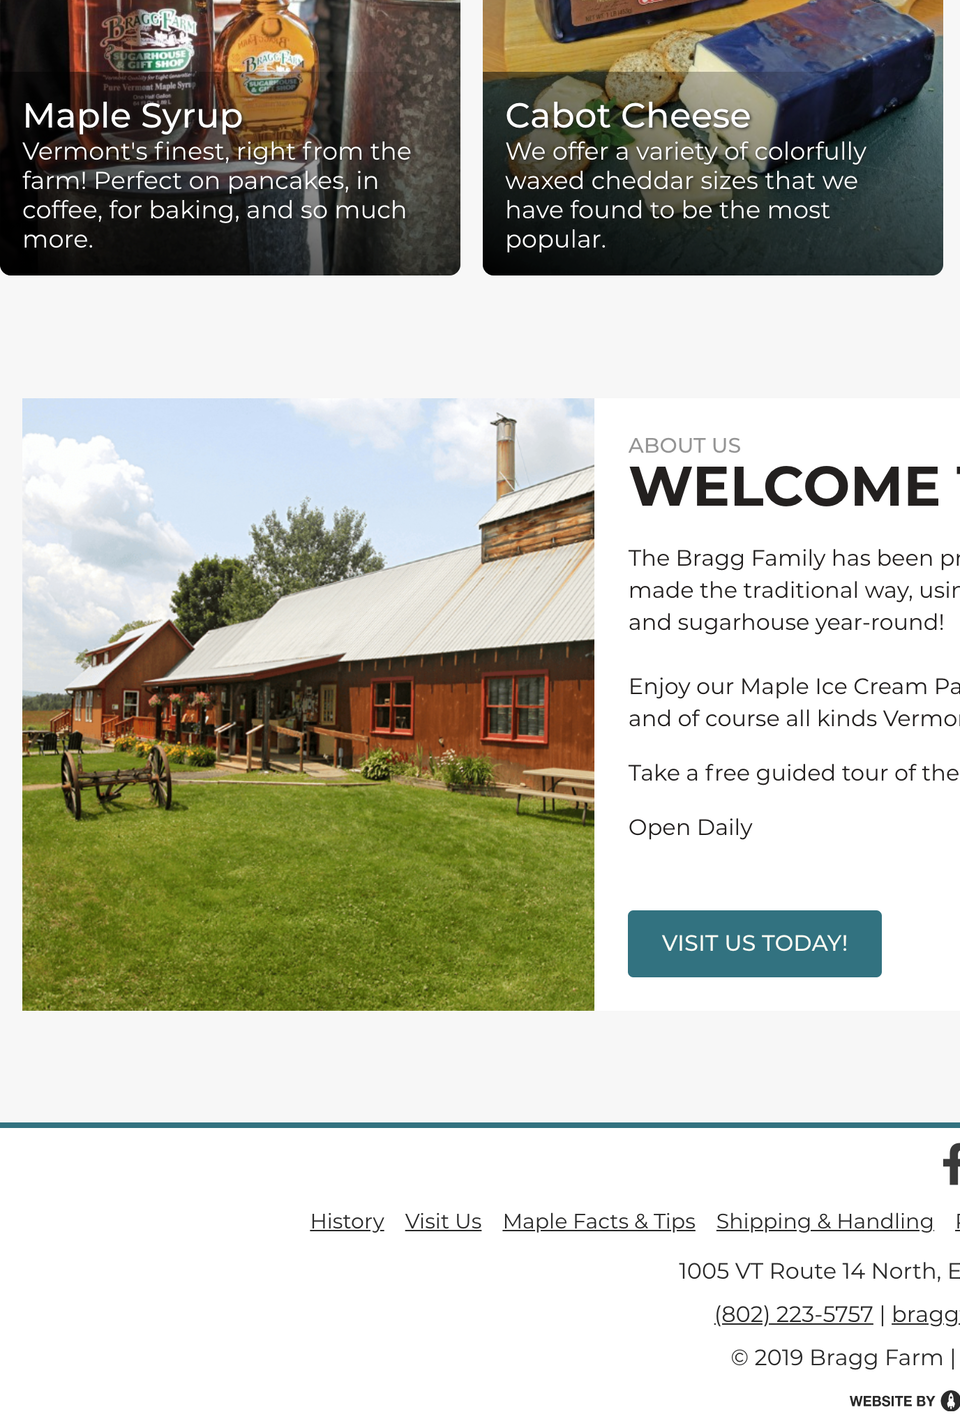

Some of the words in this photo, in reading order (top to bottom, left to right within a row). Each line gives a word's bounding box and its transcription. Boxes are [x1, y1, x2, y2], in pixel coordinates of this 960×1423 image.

[100, 11, 159, 47] BRAGG
[158, 9, 198, 36] FARM
[113, 50, 186, 61] SUGARHOUSE
[128, 60, 152, 69] GIFT
[155, 58, 184, 69] SHOP
[103, 83, 121, 92] Pure
[122, 82, 154, 92] Vermont
[155, 81, 176, 93] Maple
[628, 437, 707, 454] ABOUT
[713, 437, 741, 454] US
[629, 465, 940, 508] WELCOME
[661, 934, 719, 952] VISIT
[725, 934, 756, 952] US
[761, 934, 847, 952] TODAY!
[678, 1262, 730, 1280] 1005
[734, 1262, 764, 1280] VT
[770, 1262, 837, 1280] Route
[841, 1262, 866, 1280] 14
[872, 1261, 941, 1283] North,
[849, 1394, 913, 1408] WEBSITE
[916, 1395, 936, 1407] BY
